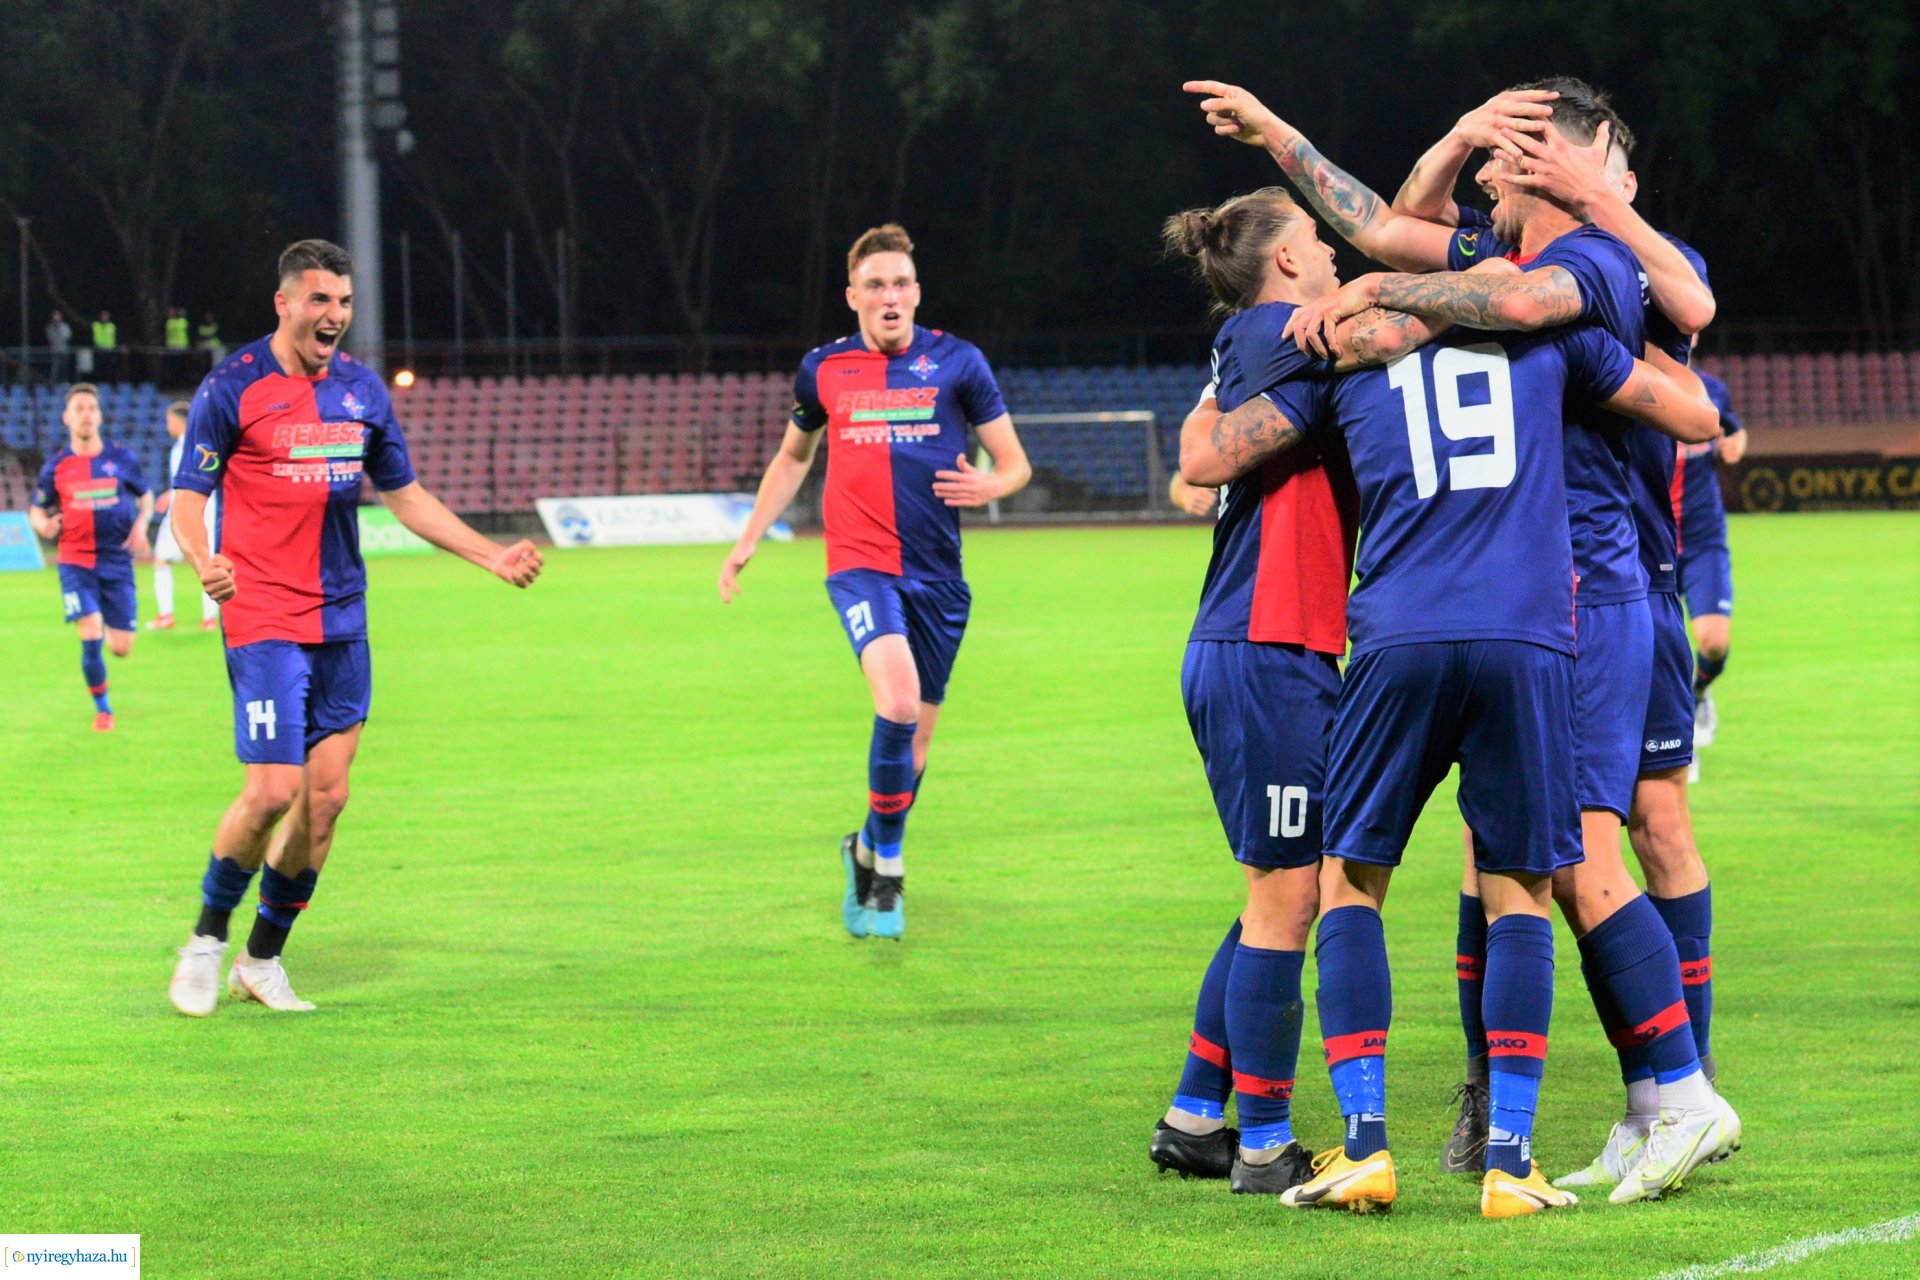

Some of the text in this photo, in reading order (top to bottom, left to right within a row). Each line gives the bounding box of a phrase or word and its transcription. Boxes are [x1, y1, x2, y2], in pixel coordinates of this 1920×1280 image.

[837, 387, 939, 413] REVESZ
[271, 421, 366, 448] REVESZ
[1386, 342, 1517, 499] 19
[1788, 467, 1882, 498] ONYX
[846, 600, 875, 642] 21
[246, 699, 276, 741] 14
[1659, 739, 1682, 750] JAKO
[1266, 784, 1309, 838] 10
